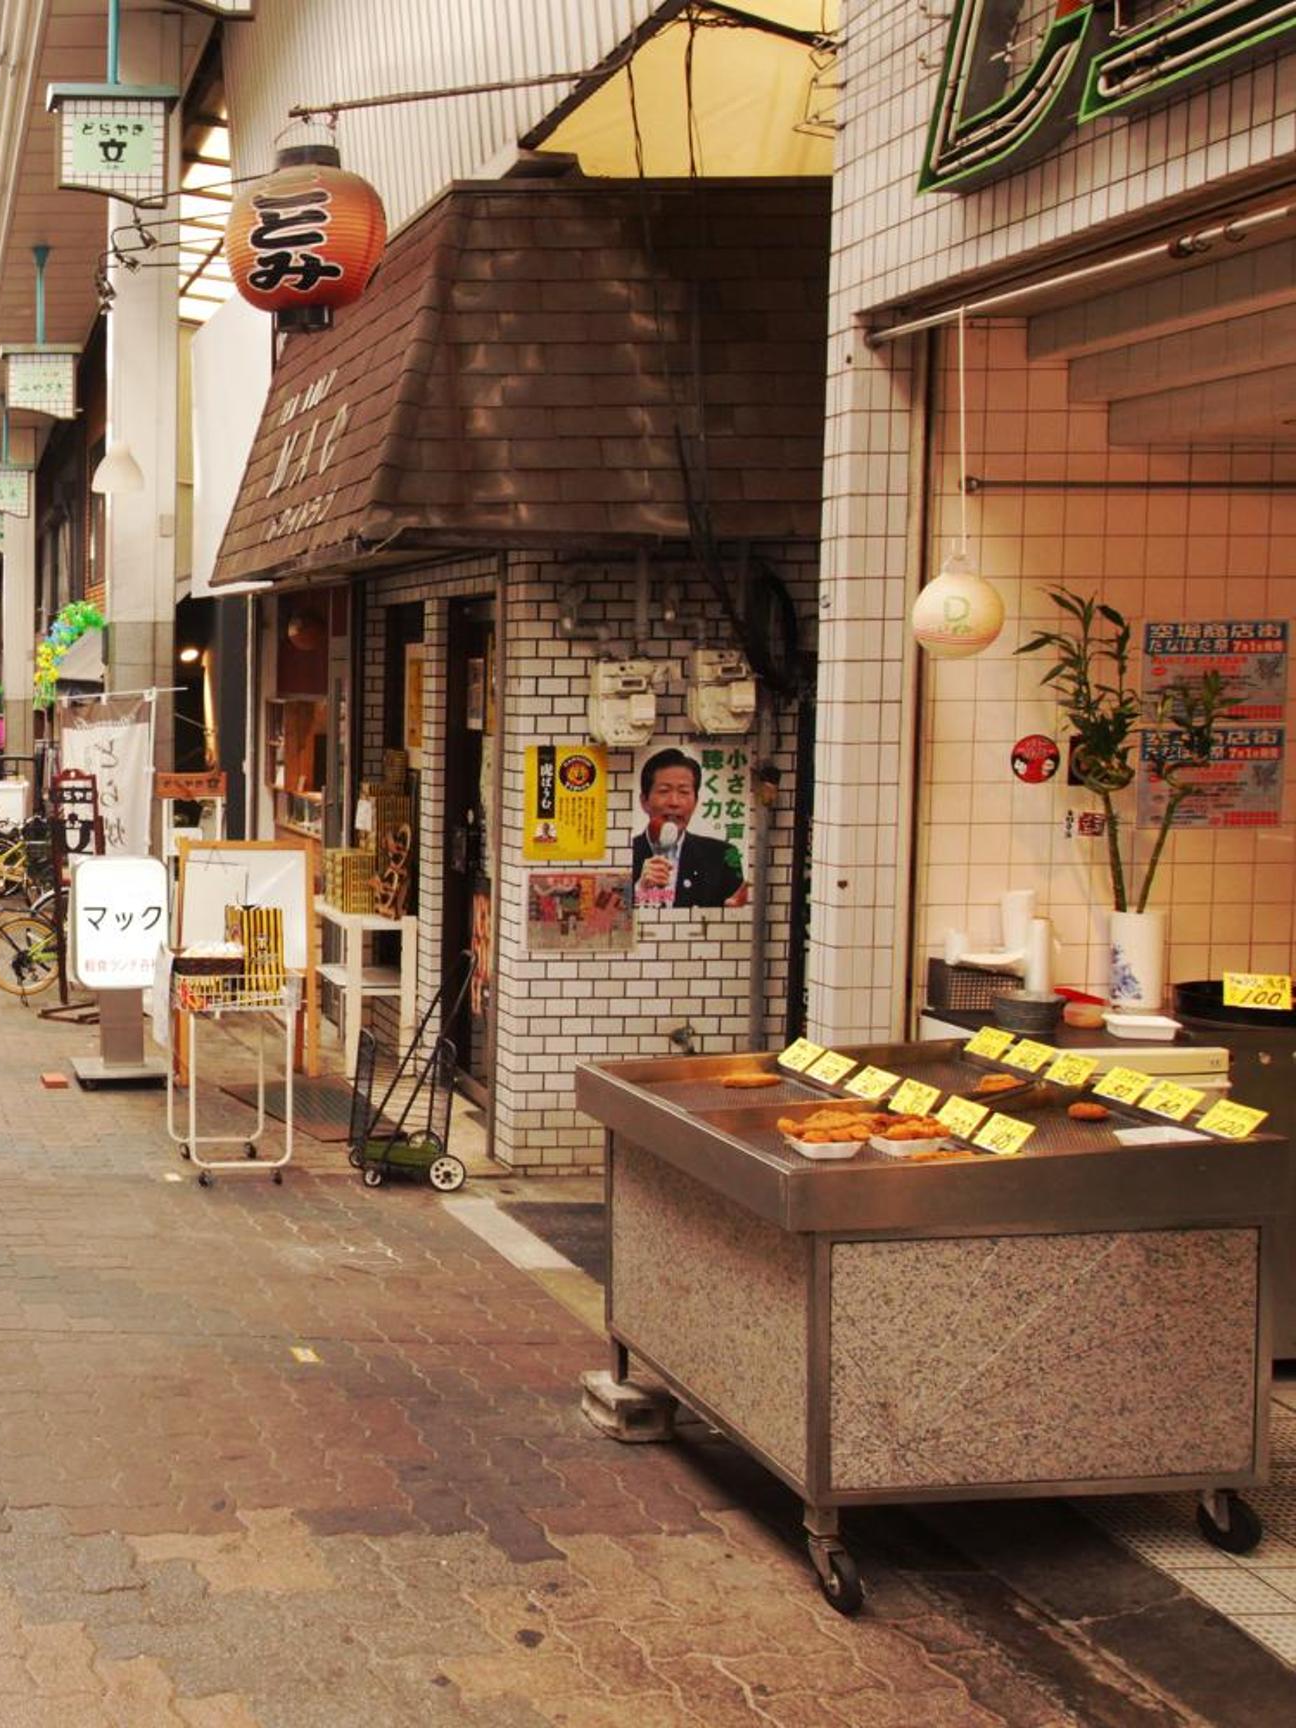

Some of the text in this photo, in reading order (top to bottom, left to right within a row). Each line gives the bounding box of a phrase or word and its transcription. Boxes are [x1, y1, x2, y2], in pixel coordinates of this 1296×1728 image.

[82, 122, 145, 135] どらやき
[83, 906, 162, 931] マック
